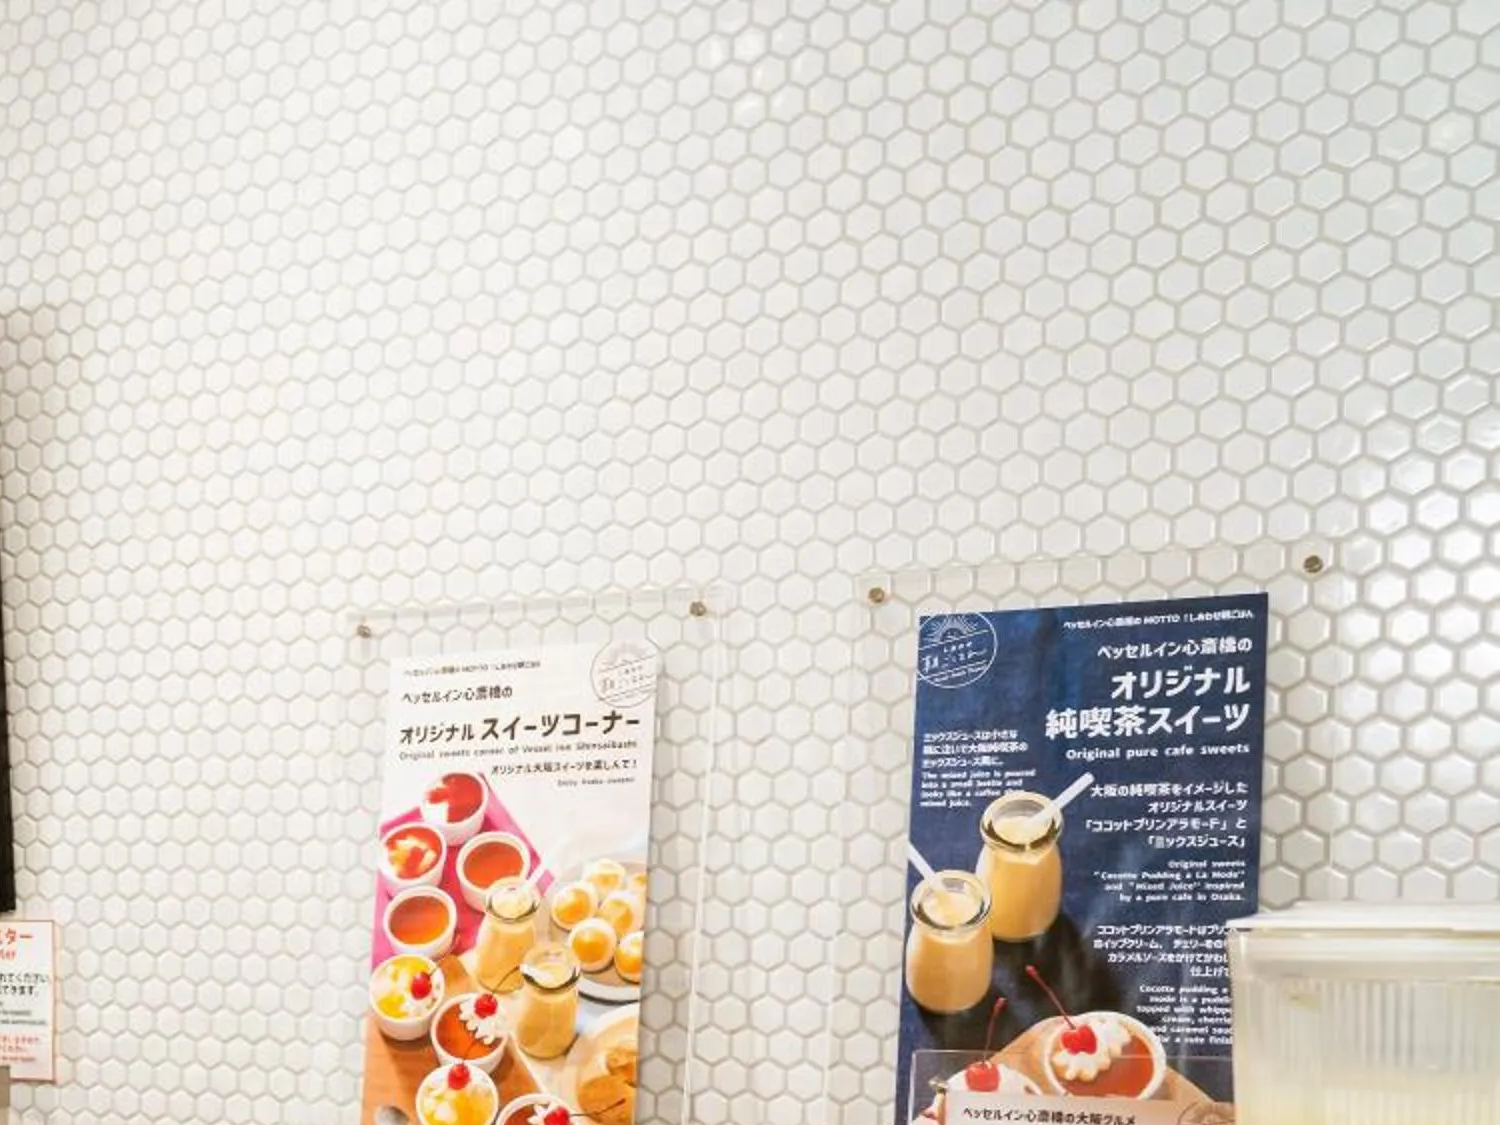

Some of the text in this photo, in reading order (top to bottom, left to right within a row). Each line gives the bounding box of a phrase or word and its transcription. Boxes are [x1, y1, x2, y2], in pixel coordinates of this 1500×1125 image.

[1097, 637, 1253, 659] ベッセルイン心斎橋の
[1111, 665, 1251, 700] オリジナル
[399, 710, 640, 744] オリジナル スイーツコーナー
[1044, 703, 1250, 740] 純喫茶スイーツ
[1066, 744, 1250, 762] Original pure cafe sweets
[1147, 799, 1247, 813] オリジナルスイーツ
